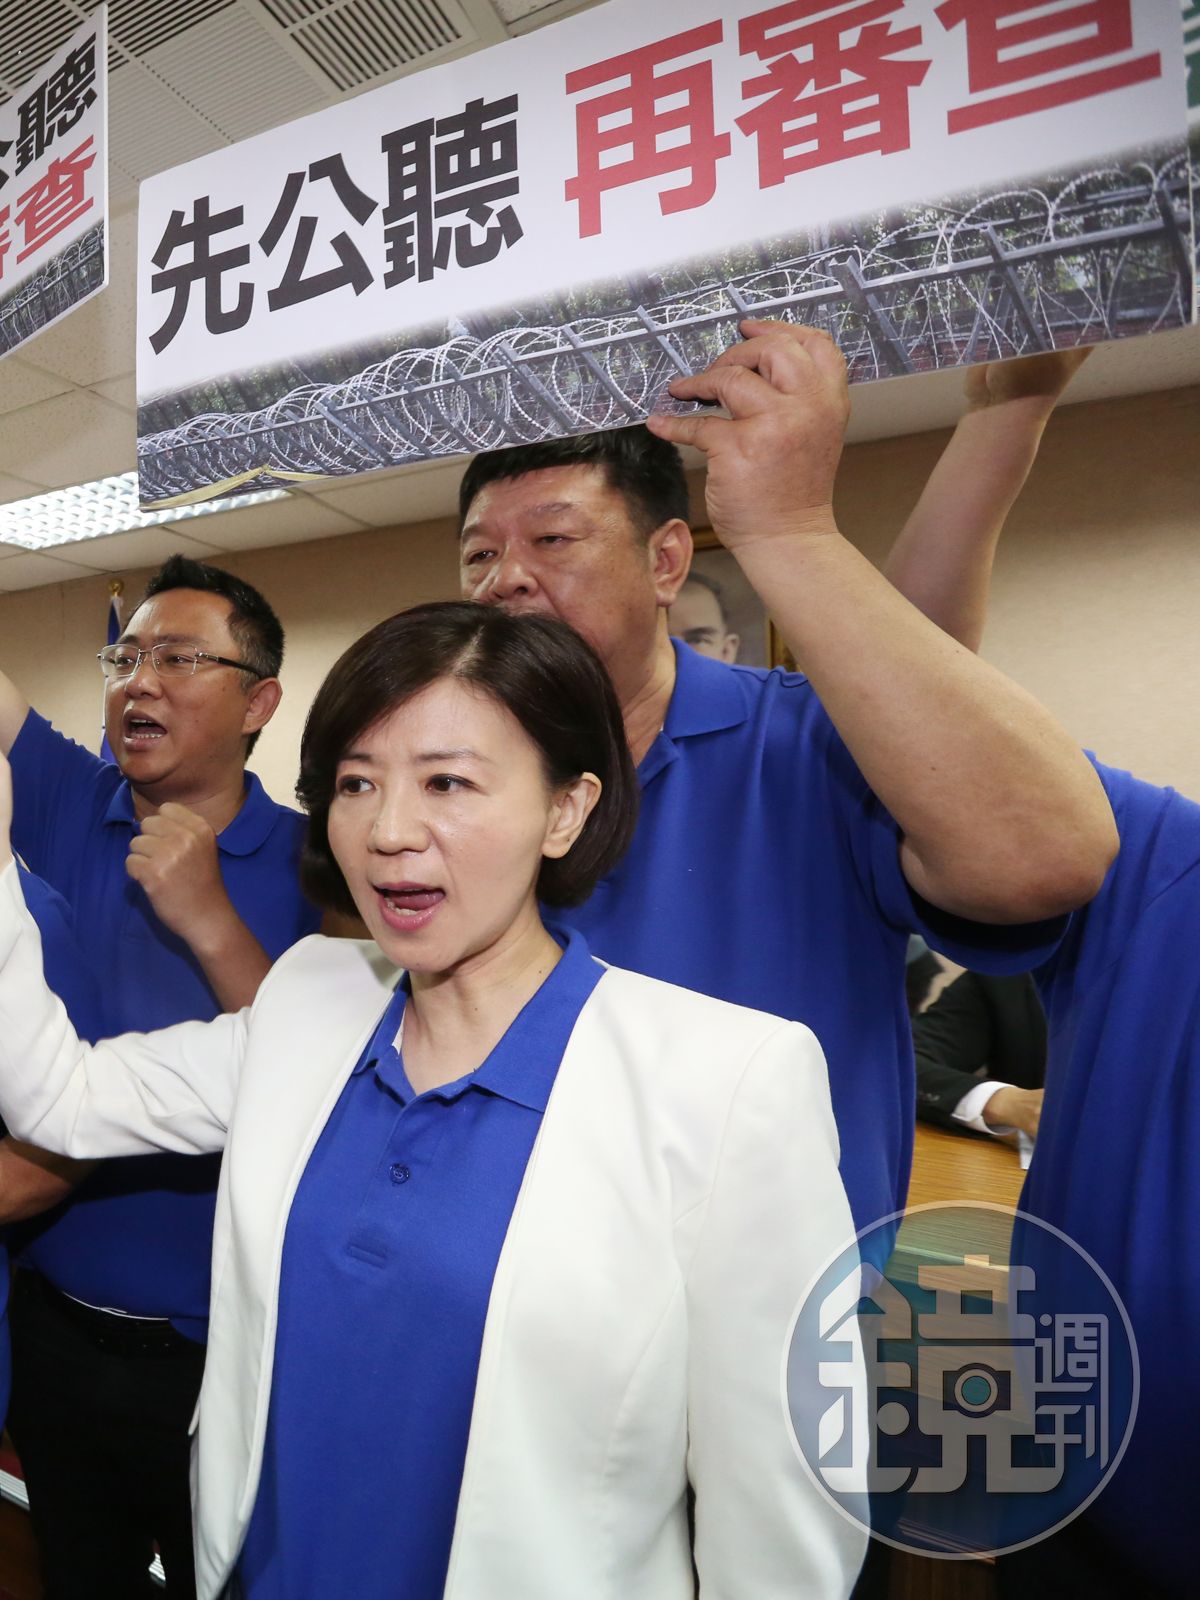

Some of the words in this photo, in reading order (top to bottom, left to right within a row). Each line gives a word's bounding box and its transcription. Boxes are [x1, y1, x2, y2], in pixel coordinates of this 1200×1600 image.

[148, 92, 525, 355] 先公聽
[565, 0, 1161, 239] 再審查
